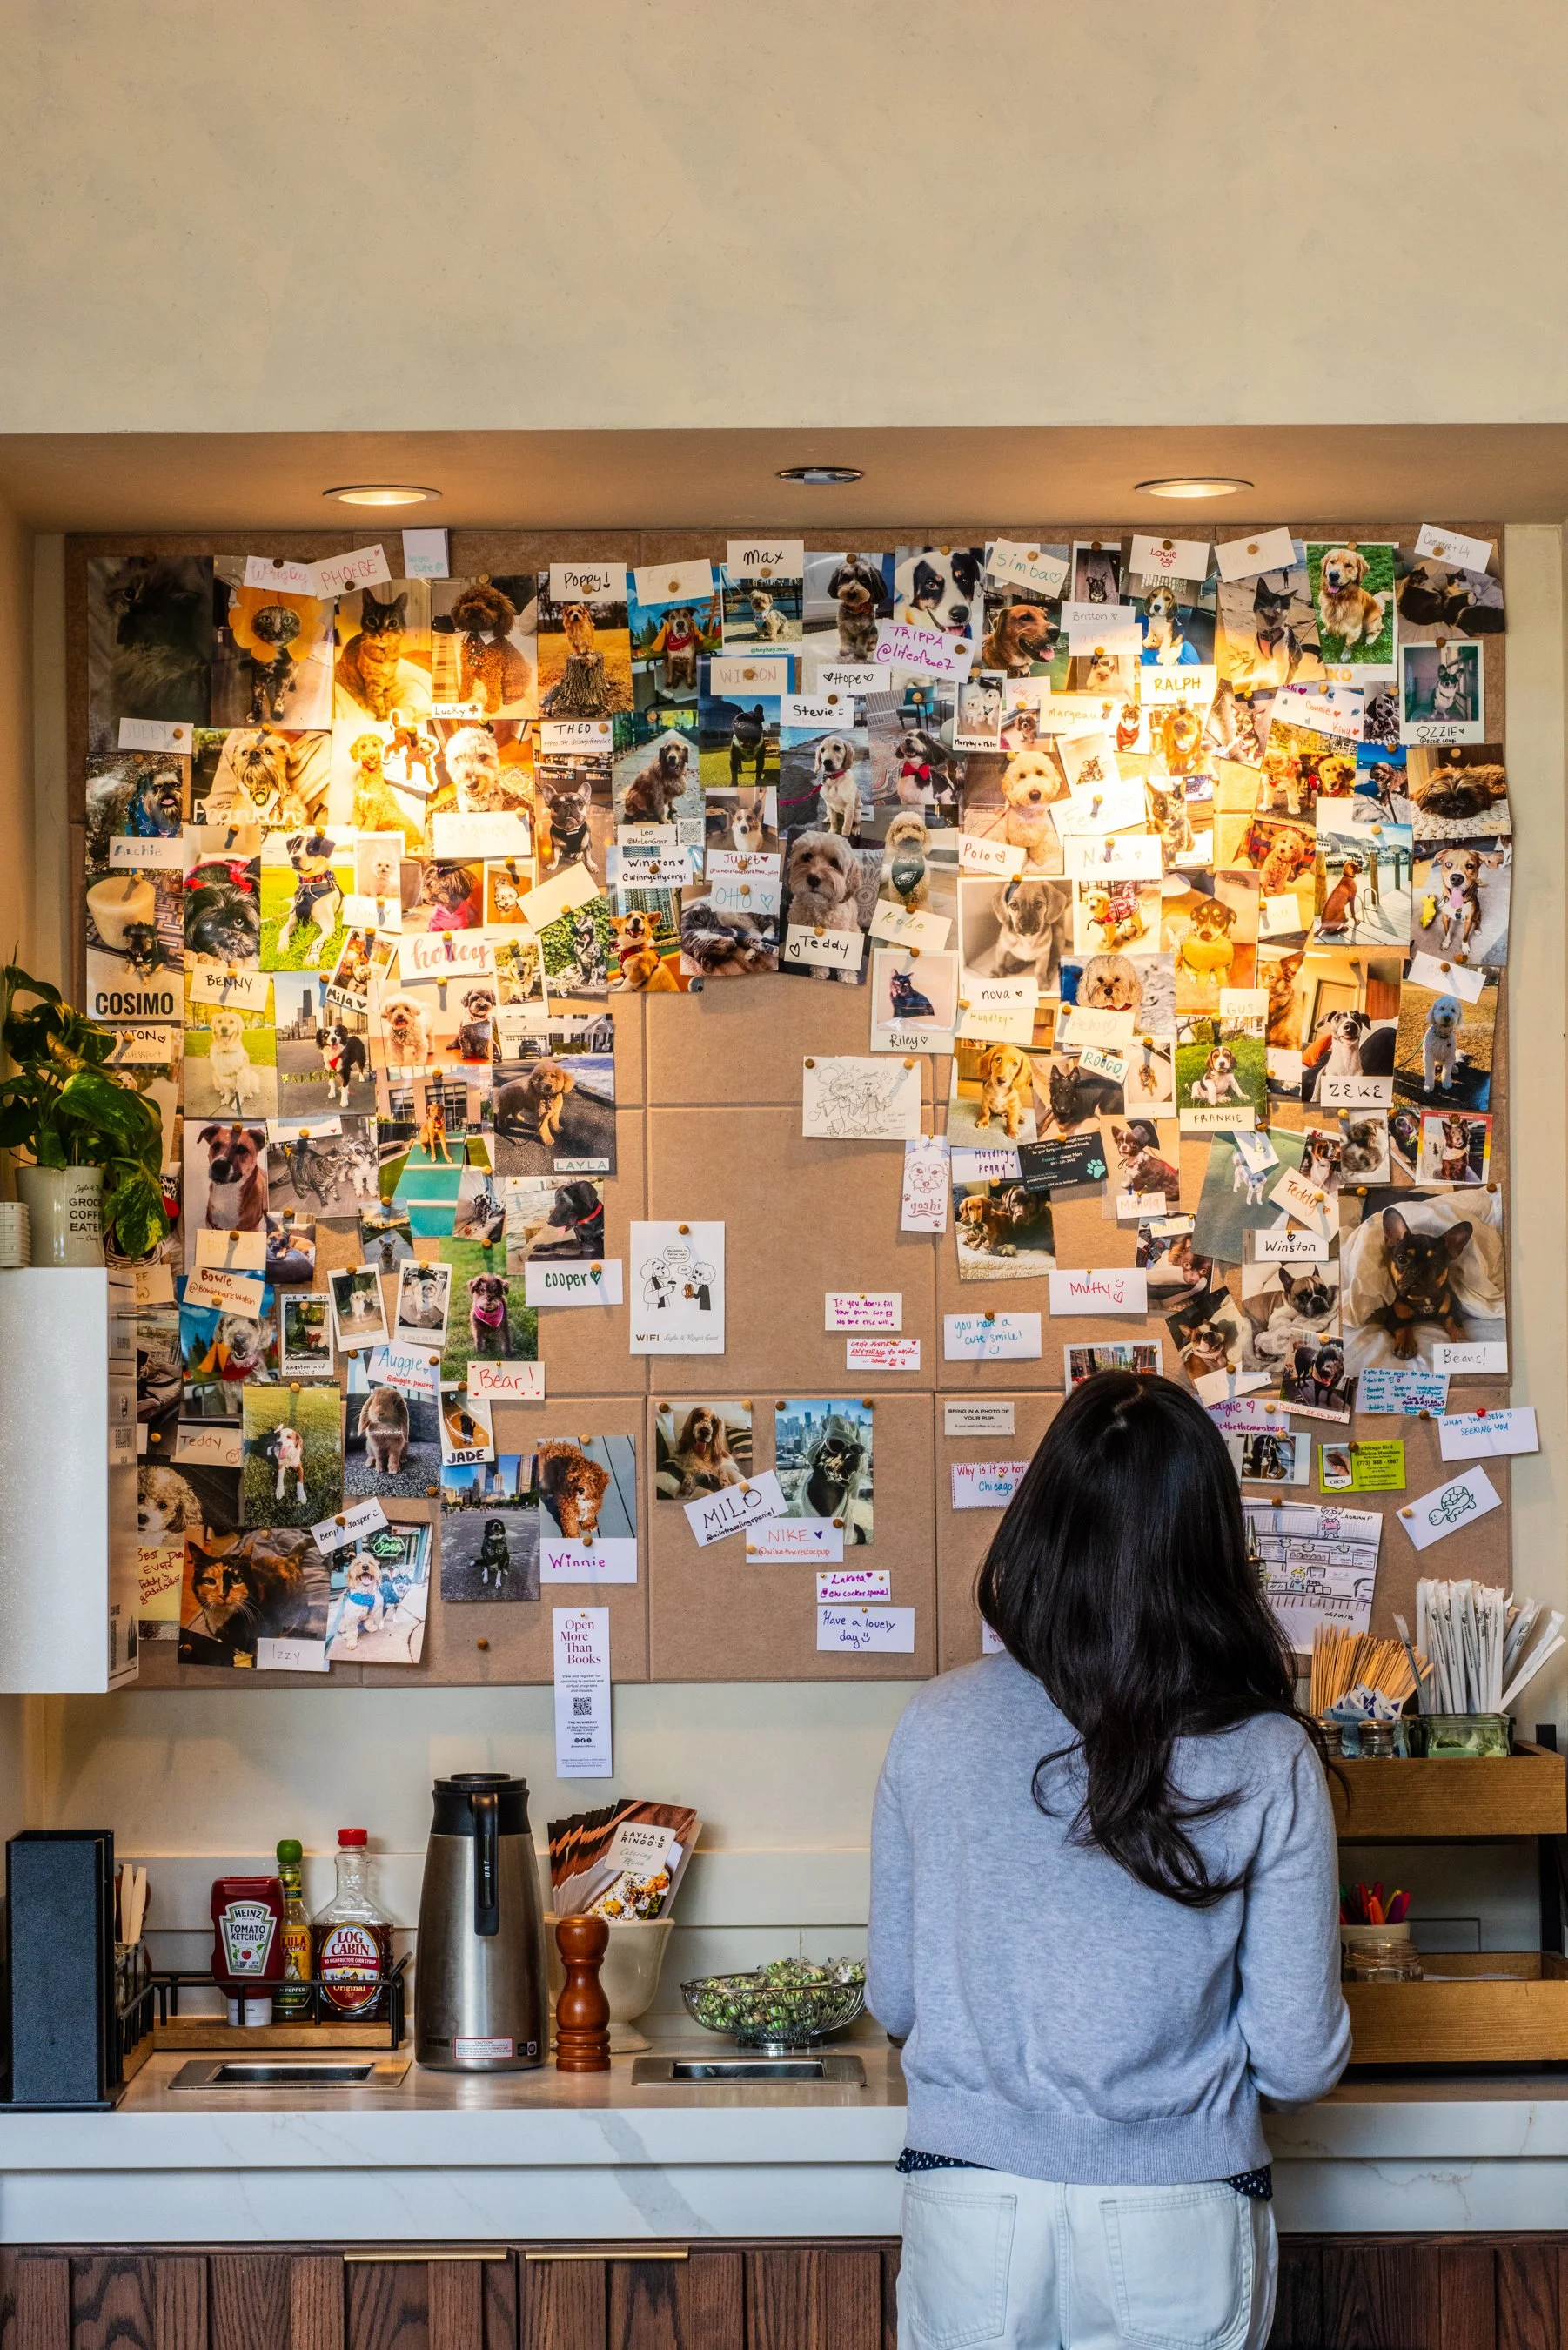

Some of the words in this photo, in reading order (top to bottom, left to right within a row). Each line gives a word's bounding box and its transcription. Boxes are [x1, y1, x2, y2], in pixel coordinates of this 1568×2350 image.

[997, 552, 1047, 581] Simba
[321, 559, 378, 590] PHOEBE
[564, 571, 611, 591] Poppy!
[1073, 611, 1108, 621] Britton
[889, 626, 945, 649] TRIPPA
[833, 672, 861, 688] Hope
[1153, 676, 1201, 692] RALPH
[793, 704, 836, 717] Stevie
[553, 723, 592, 735] THEO
[1417, 726, 1458, 738] OZZIE
[193, 798, 302, 826] Franklin
[114, 844, 163, 857] Archie
[963, 843, 991, 861] Polo
[628, 857, 676, 870] Winston
[881, 911, 925, 933] Kobe
[800, 935, 849, 958] Teddy
[412, 938, 490, 970] honey
[205, 974, 253, 993] BENNY
[96, 993, 173, 1016] COSIMO
[326, 989, 353, 1008] Mila
[889, 1034, 918, 1050] Riley
[1329, 1084, 1383, 1098] ZEKE
[1193, 1113, 1243, 1124] FRANKIE
[555, 1159, 607, 1170] LAYLA
[910, 1198, 941, 1213] yoshi
[1265, 1239, 1316, 1253] Winston
[201, 1269, 232, 1286] Bowie
[545, 1271, 587, 1291] cooper
[833, 1298, 843, 1307] If
[1002, 1319, 1011, 1327] a
[965, 1333, 985, 1344] cute
[378, 1347, 423, 1377] Auggie
[1444, 1348, 1488, 1365] Beans!
[1460, 1425, 1492, 1436] SEEKING
[180, 1435, 222, 1448] Teddy
[446, 1449, 485, 1464] JADE
[956, 1465, 975, 1480] Why
[989, 1465, 997, 1474] it
[1011, 1464, 1025, 1474] hot
[703, 1488, 762, 1528] MILO
[318, 1526, 339, 1541] Benji
[767, 1528, 811, 1542] NIKE
[548, 1553, 606, 1569] Winnie
[565, 1619, 594, 1632] Open
[823, 1610, 847, 1626] Have
[865, 1611, 895, 1632] lovely
[560, 1631, 588, 1642] More
[840, 1634, 861, 1648] day
[564, 1642, 593, 1653] Than
[567, 1654, 601, 1664] Books
[620, 1836, 664, 1849] RINGO'S
[623, 1830, 655, 1841] LAYLA
[620, 1848, 653, 1861] Catering
[234, 1909, 263, 1919] HEINZ
[229, 1924, 266, 1934] TOMATO
[231, 1933, 265, 1942] KETCHUP
[337, 1931, 364, 1944] LOG
[332, 1944, 370, 1957] CABIN
